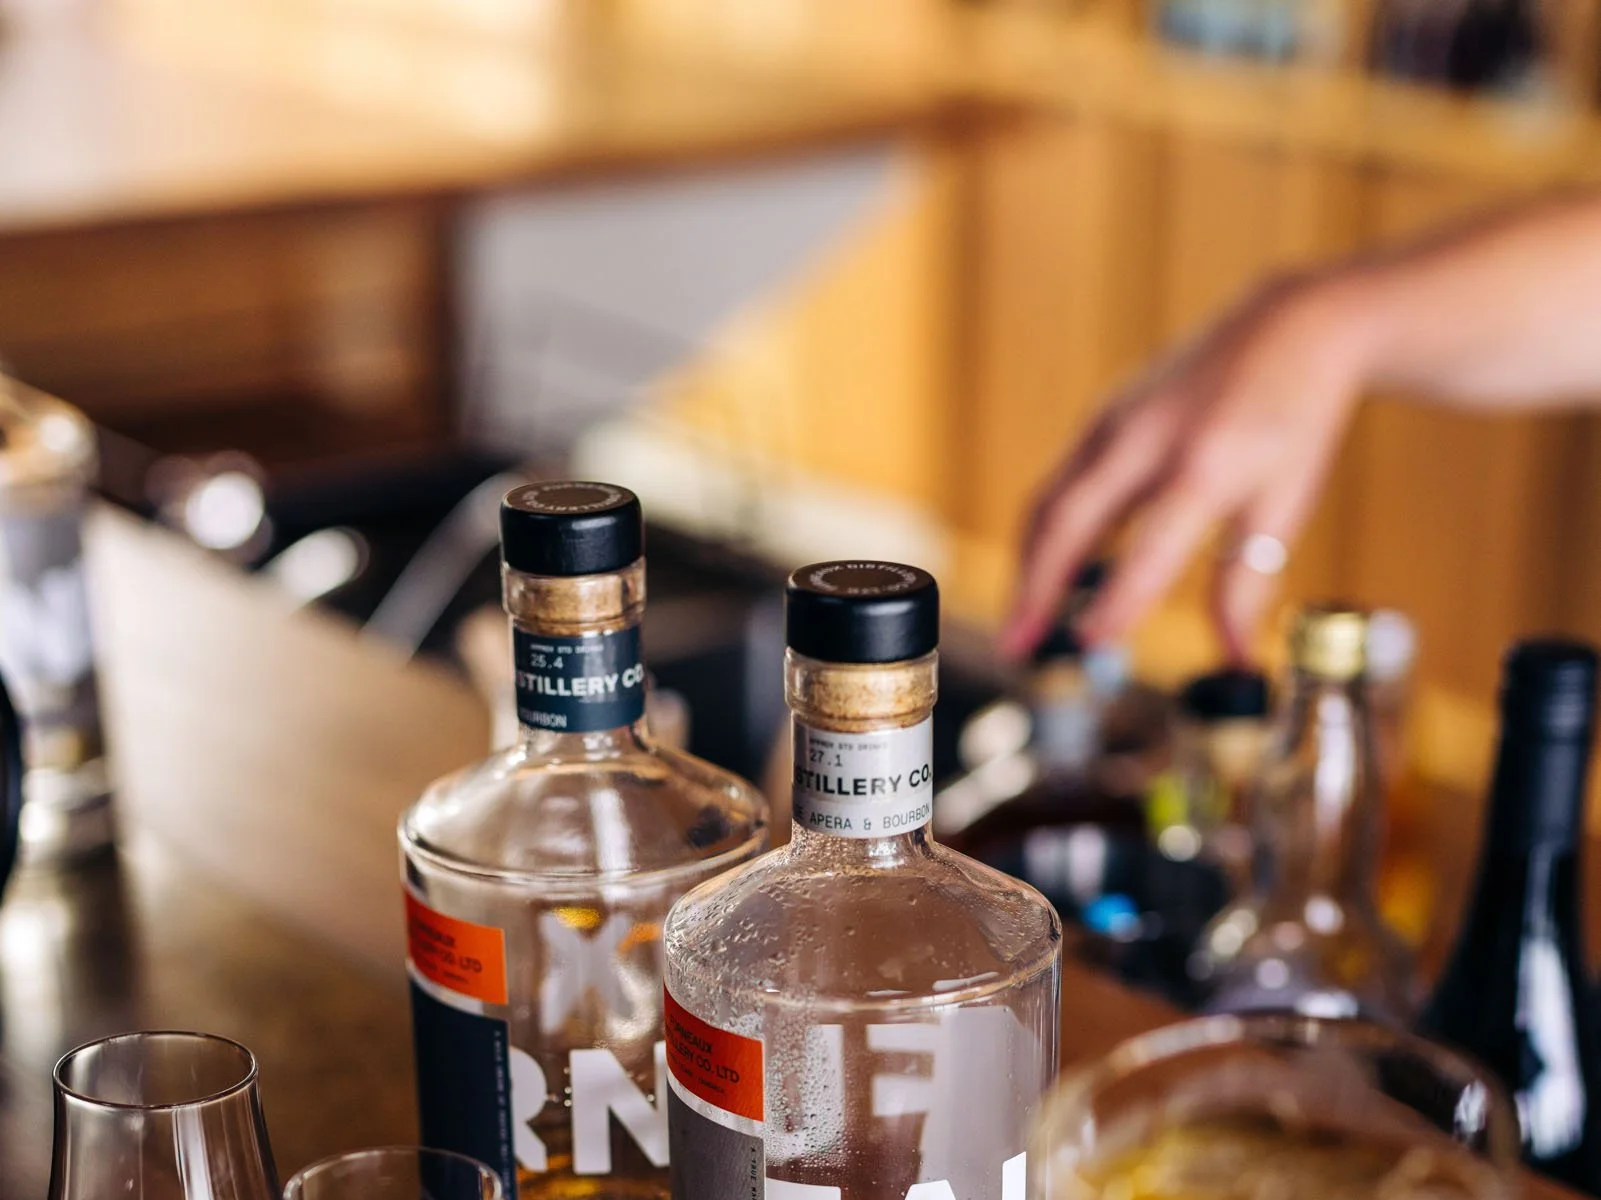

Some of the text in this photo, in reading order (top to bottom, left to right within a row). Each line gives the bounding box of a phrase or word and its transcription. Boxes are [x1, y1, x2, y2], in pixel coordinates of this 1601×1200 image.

[530, 653, 564, 670] 25.4
[809, 749, 843, 768] 27.1
[810, 811, 853, 831] APERA
[863, 818, 872, 831] &
[882, 802, 931, 831] BOURBON
[716, 1063, 741, 1084] LTD
